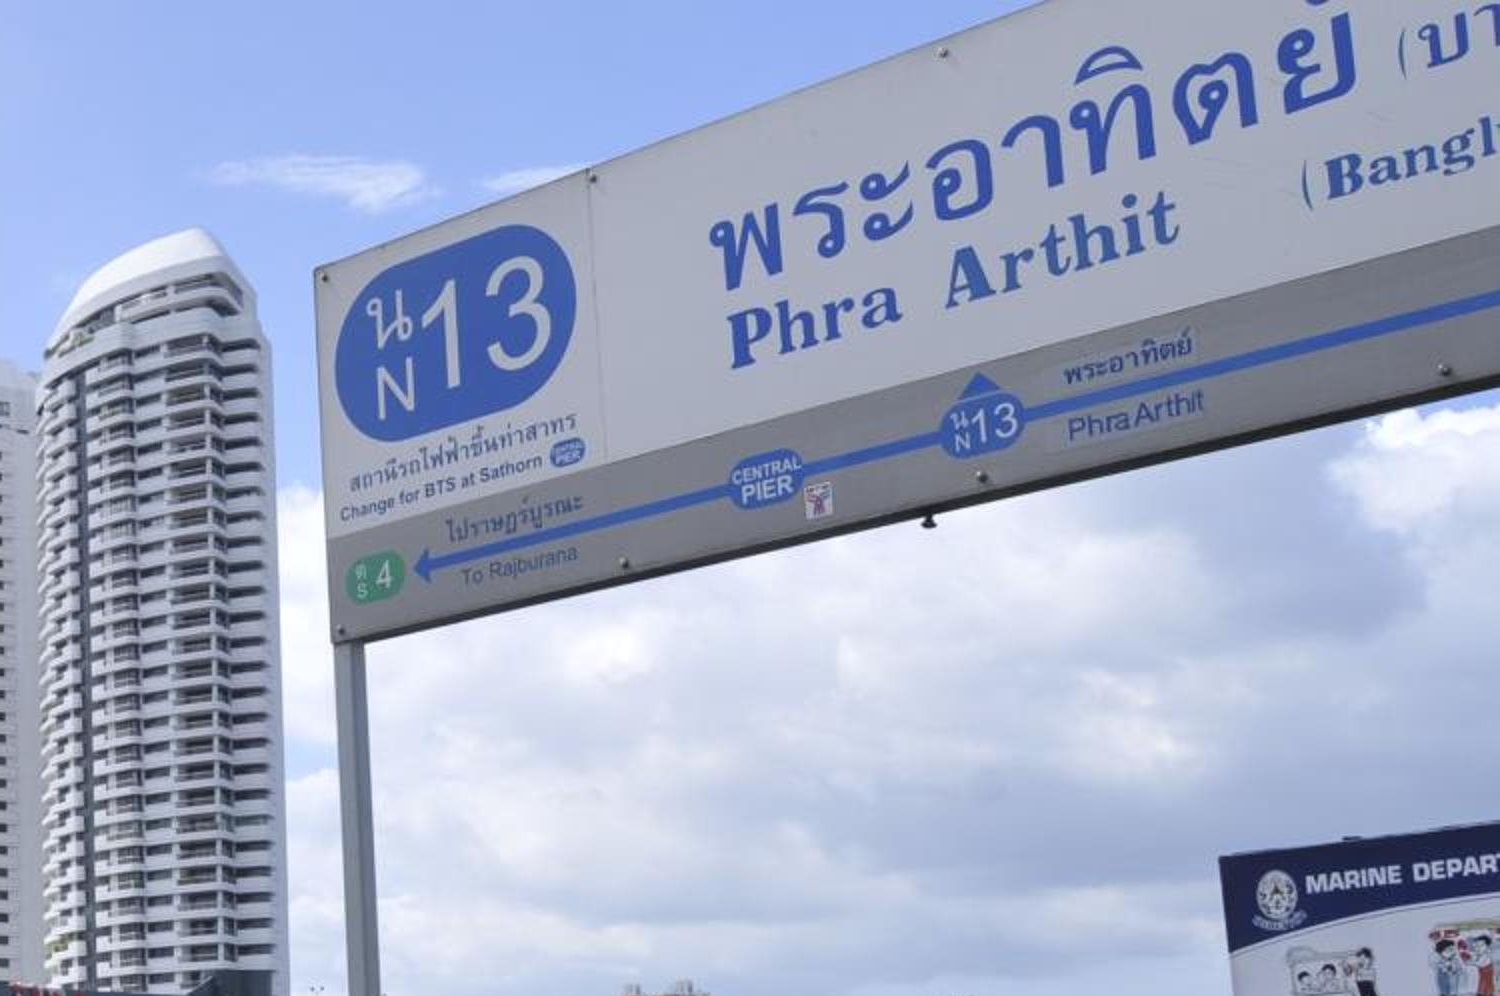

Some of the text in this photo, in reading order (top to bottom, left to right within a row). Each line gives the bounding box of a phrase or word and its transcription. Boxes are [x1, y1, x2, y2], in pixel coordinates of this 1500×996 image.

[709, 0, 1357, 291] พระอาทิตย
[726, 116, 1500, 369] Phra Arthit (Bangl
[366, 289, 412, 349] น
[421, 255, 552, 389] 13
[1063, 326, 1192, 385] พระอาทิตย์
[376, 357, 415, 420] N
[954, 431, 971, 453] N
[971, 402, 1018, 443] 13
[341, 455, 543, 521] Change for BTS at Sathorn
[732, 456, 802, 485] CENTRAL
[741, 475, 793, 505] PIER
[375, 559, 393, 588] 4
[462, 547, 578, 586] To Rajburana
[357, 583, 368, 599] S
[1306, 852, 1500, 894] MARINE DEPAR
